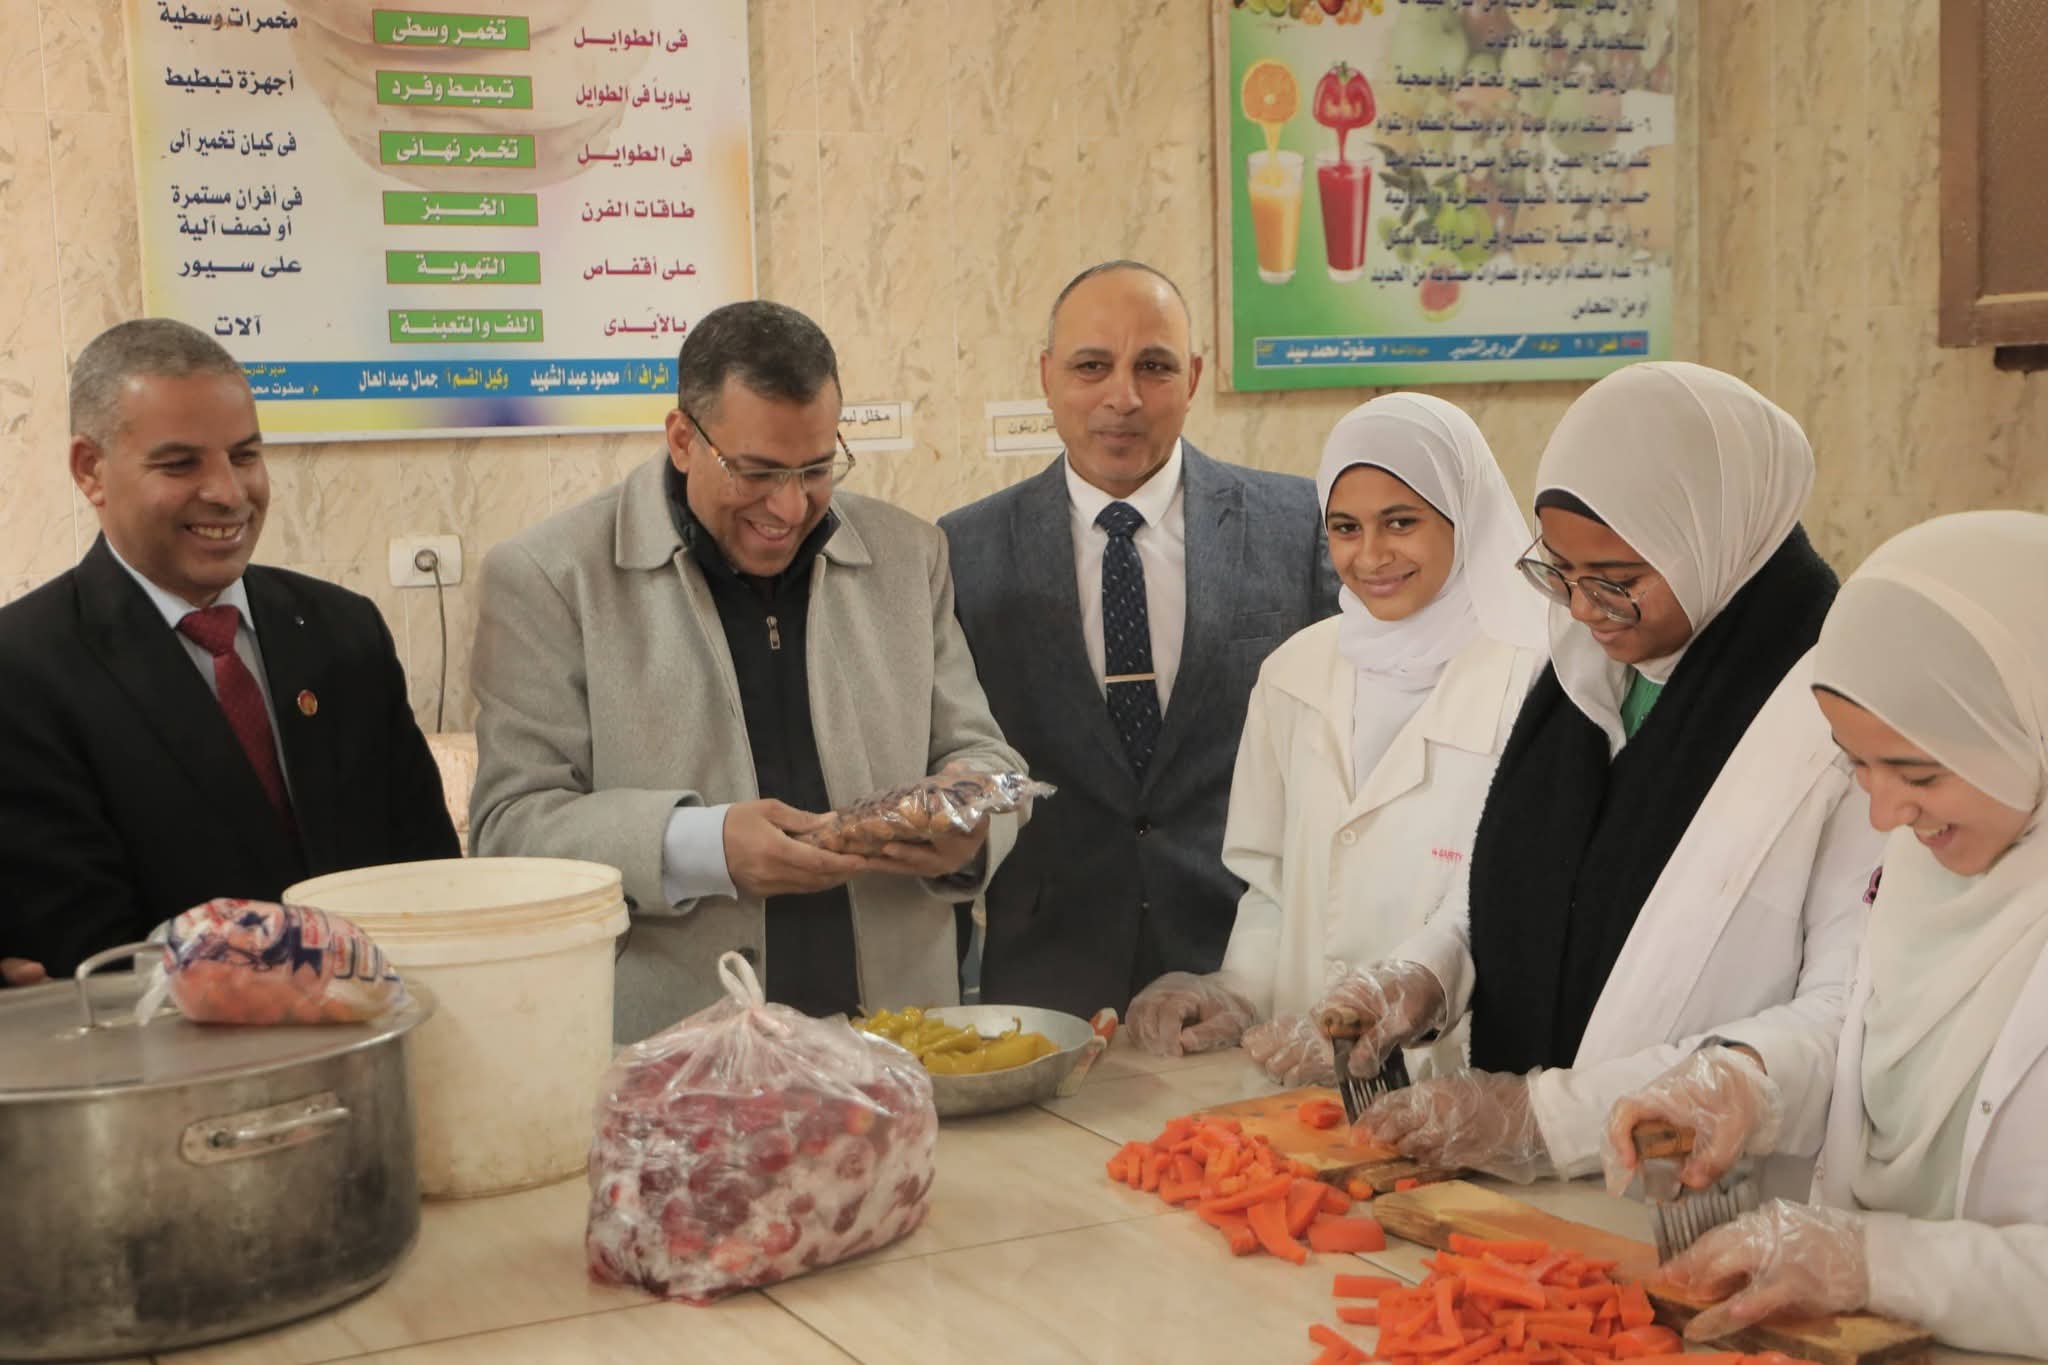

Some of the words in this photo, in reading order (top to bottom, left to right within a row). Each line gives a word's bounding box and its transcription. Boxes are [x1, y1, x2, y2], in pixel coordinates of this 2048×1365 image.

[157, 0, 223, 31] وسطية
[227, 7, 299, 33] مخمرات
[392, 16, 449, 43] وسطى
[453, 19, 507, 45] تخمر
[165, 67, 234, 94] تبطيط
[238, 69, 295, 96] أجهزة
[392, 75, 443, 101] وفرد
[447, 77, 514, 104] تبطيط
[197, 129, 235, 156] تخمير
[240, 131, 274, 156] كيان
[466, 138, 519, 163] تخمر
[172, 184, 231, 210] مستمرة
[236, 184, 277, 211] أفران
[421, 196, 505, 221] الخبز
[633, 199, 696, 219] طاقات
[581, 199, 629, 222] الفرن
[177, 213, 217, 241] آلية
[220, 217, 271, 237] نصف
[275, 215, 293, 241] أو
[177, 257, 255, 279] سيور
[260, 256, 303, 278] على
[416, 254, 506, 282] التهوية
[583, 256, 658, 280] أقفاص
[662, 259, 697, 280] على
[214, 314, 262, 337] آلات
[494, 313, 535, 334] اللف
[388, 370, 409, 392] عبد
[411, 370, 438, 392] جمال
[567, 369, 588, 391] عبد
[589, 371, 619, 390] محمود
